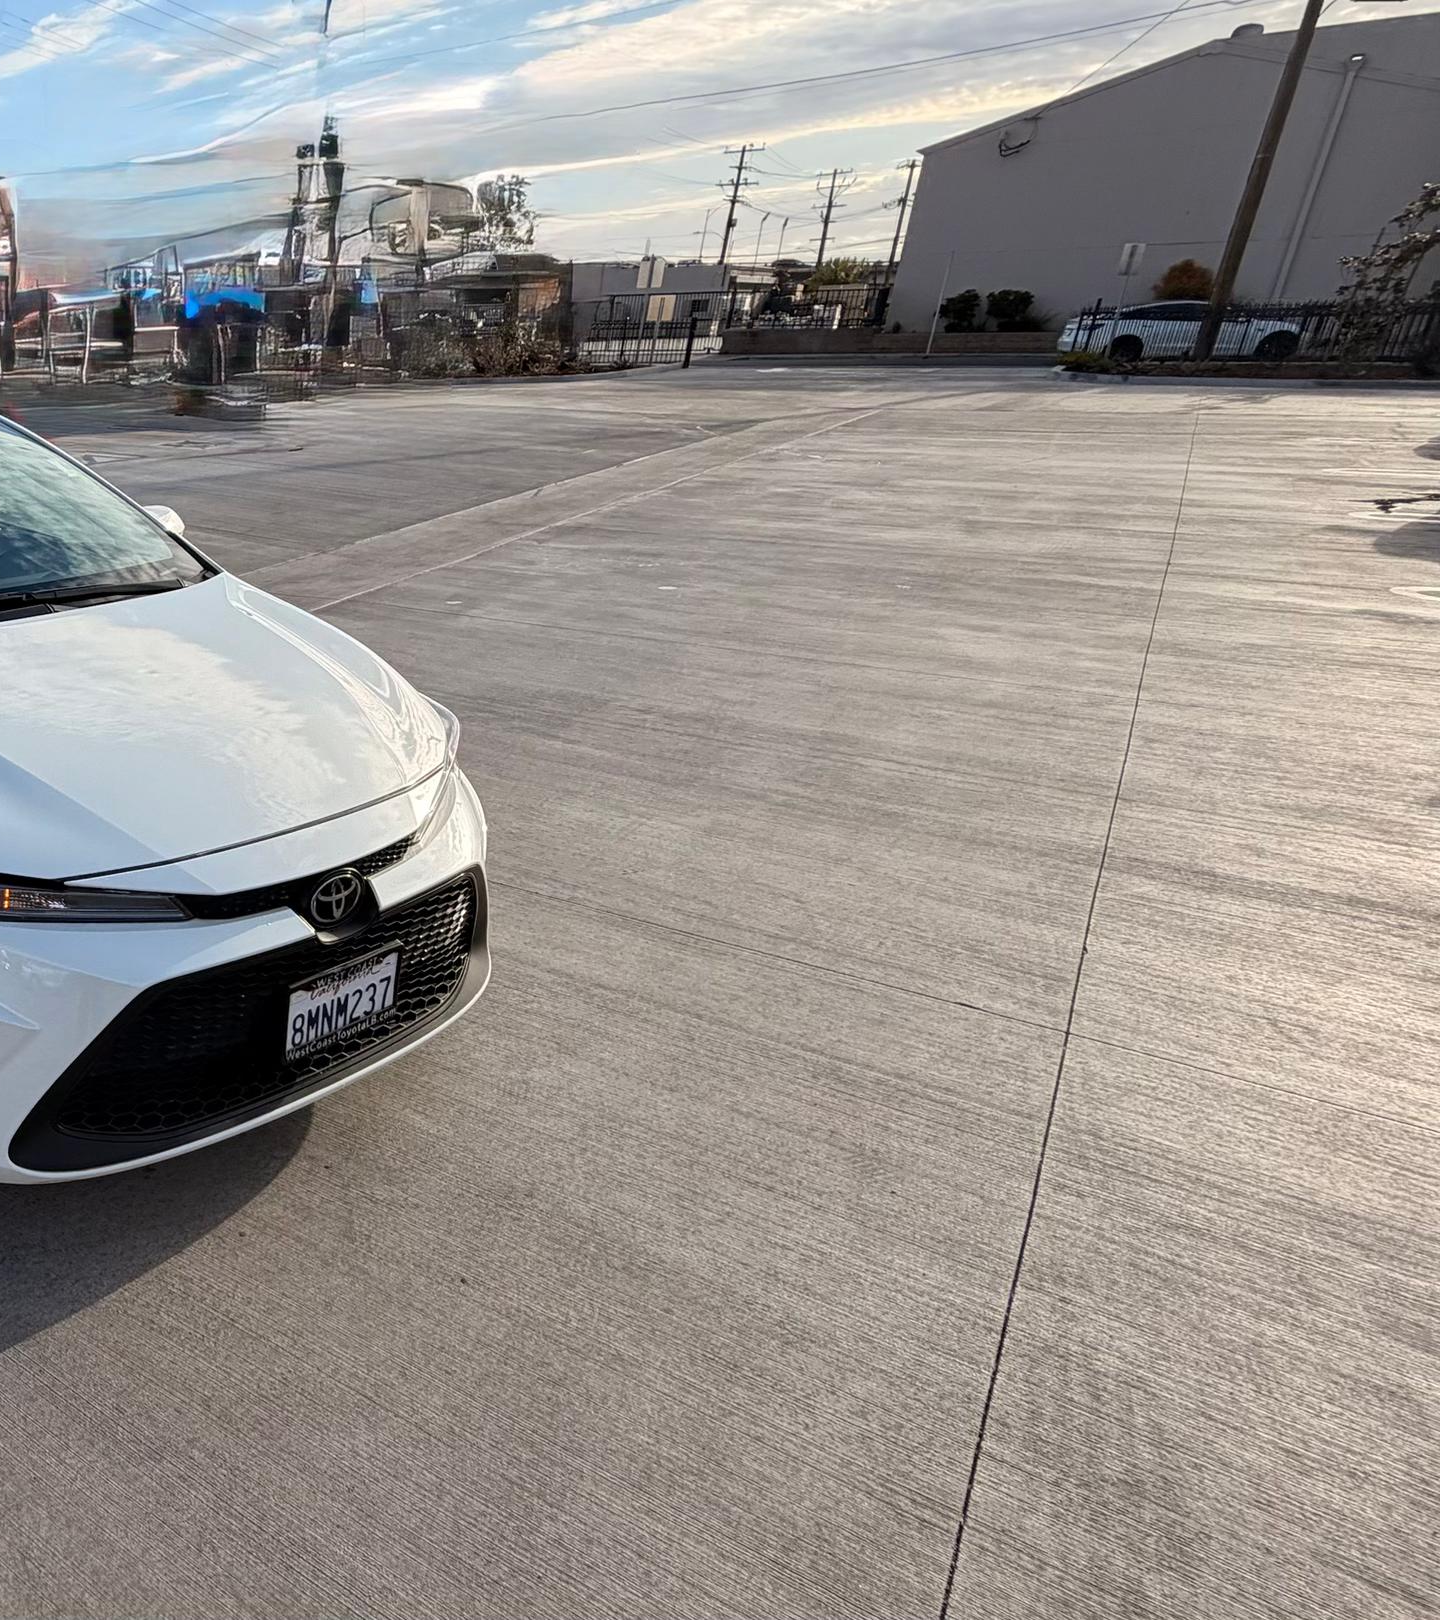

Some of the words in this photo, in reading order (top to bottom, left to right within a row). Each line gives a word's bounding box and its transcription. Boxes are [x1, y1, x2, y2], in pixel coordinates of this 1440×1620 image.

[317, 970, 345, 987] WEST
[347, 957, 378, 978] COAST
[286, 1008, 397, 1060] WestCoastToyotaLB.com
[291, 975, 391, 1048] 8MNM237
